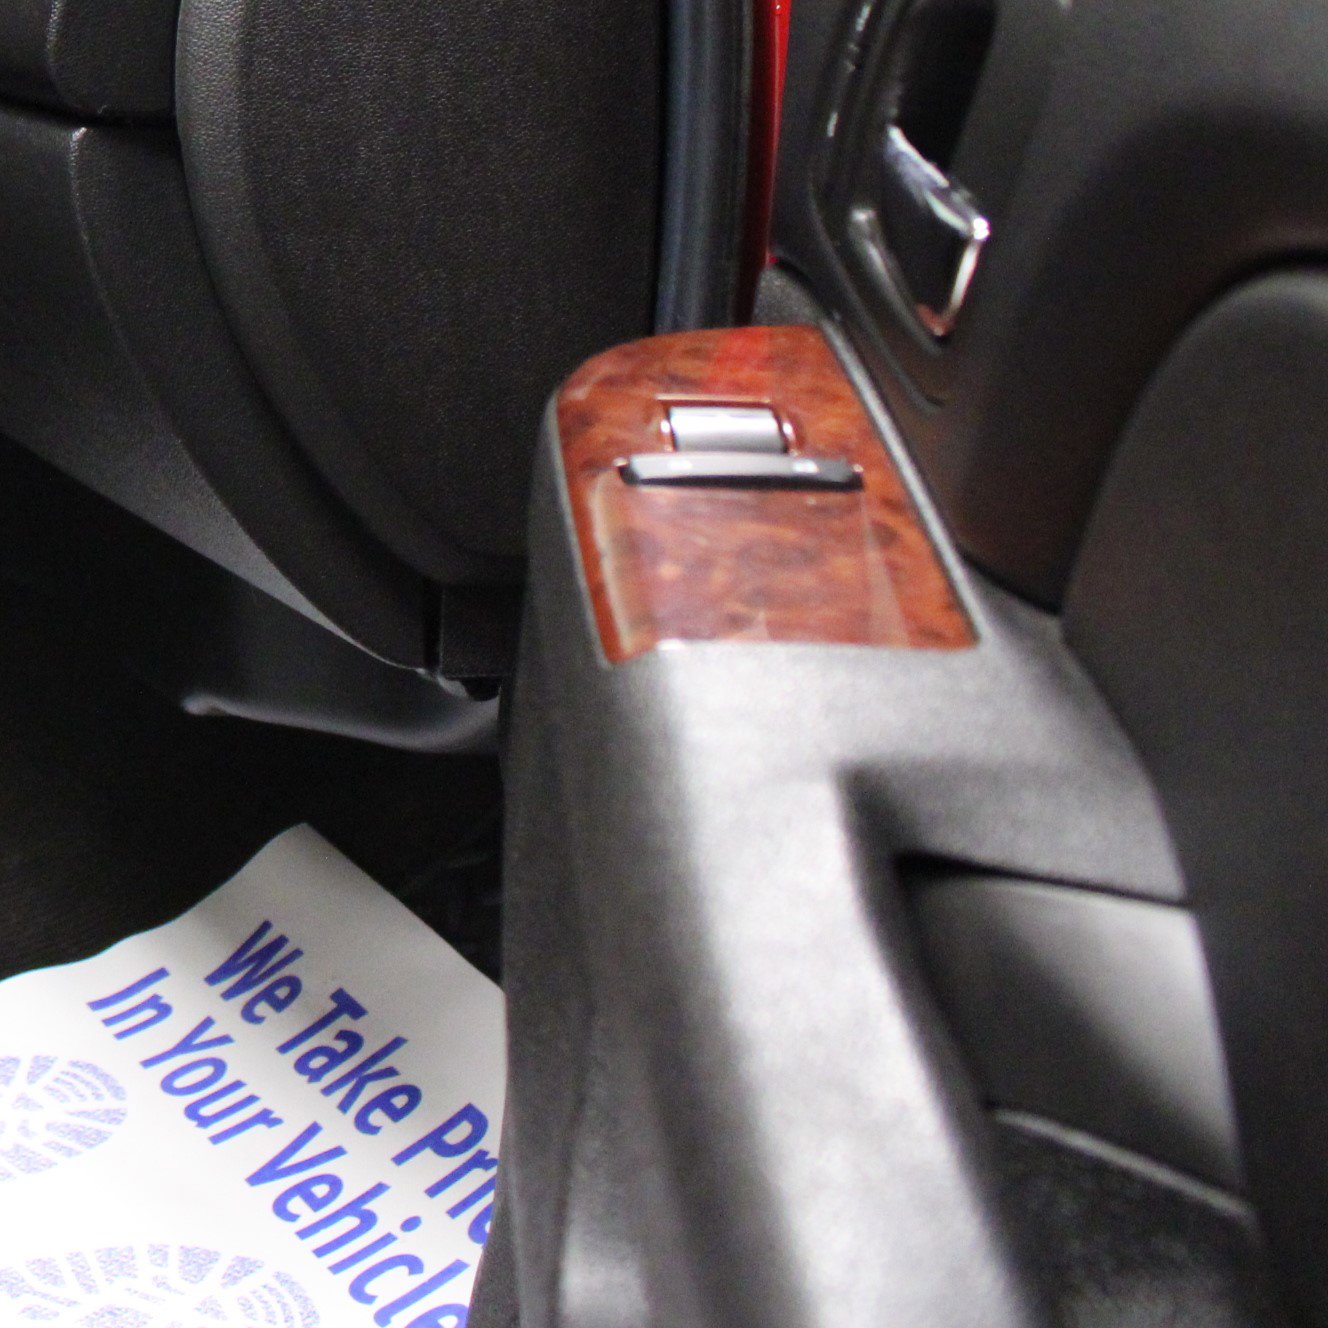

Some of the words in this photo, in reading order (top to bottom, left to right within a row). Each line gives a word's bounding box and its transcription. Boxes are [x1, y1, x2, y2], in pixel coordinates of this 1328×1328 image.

[87, 966, 173, 1040] In
[139, 1015, 284, 1145] Your
[204, 920, 303, 1024] We
[276, 987, 422, 1135] Take
[391, 1102, 498, 1249] Pri
